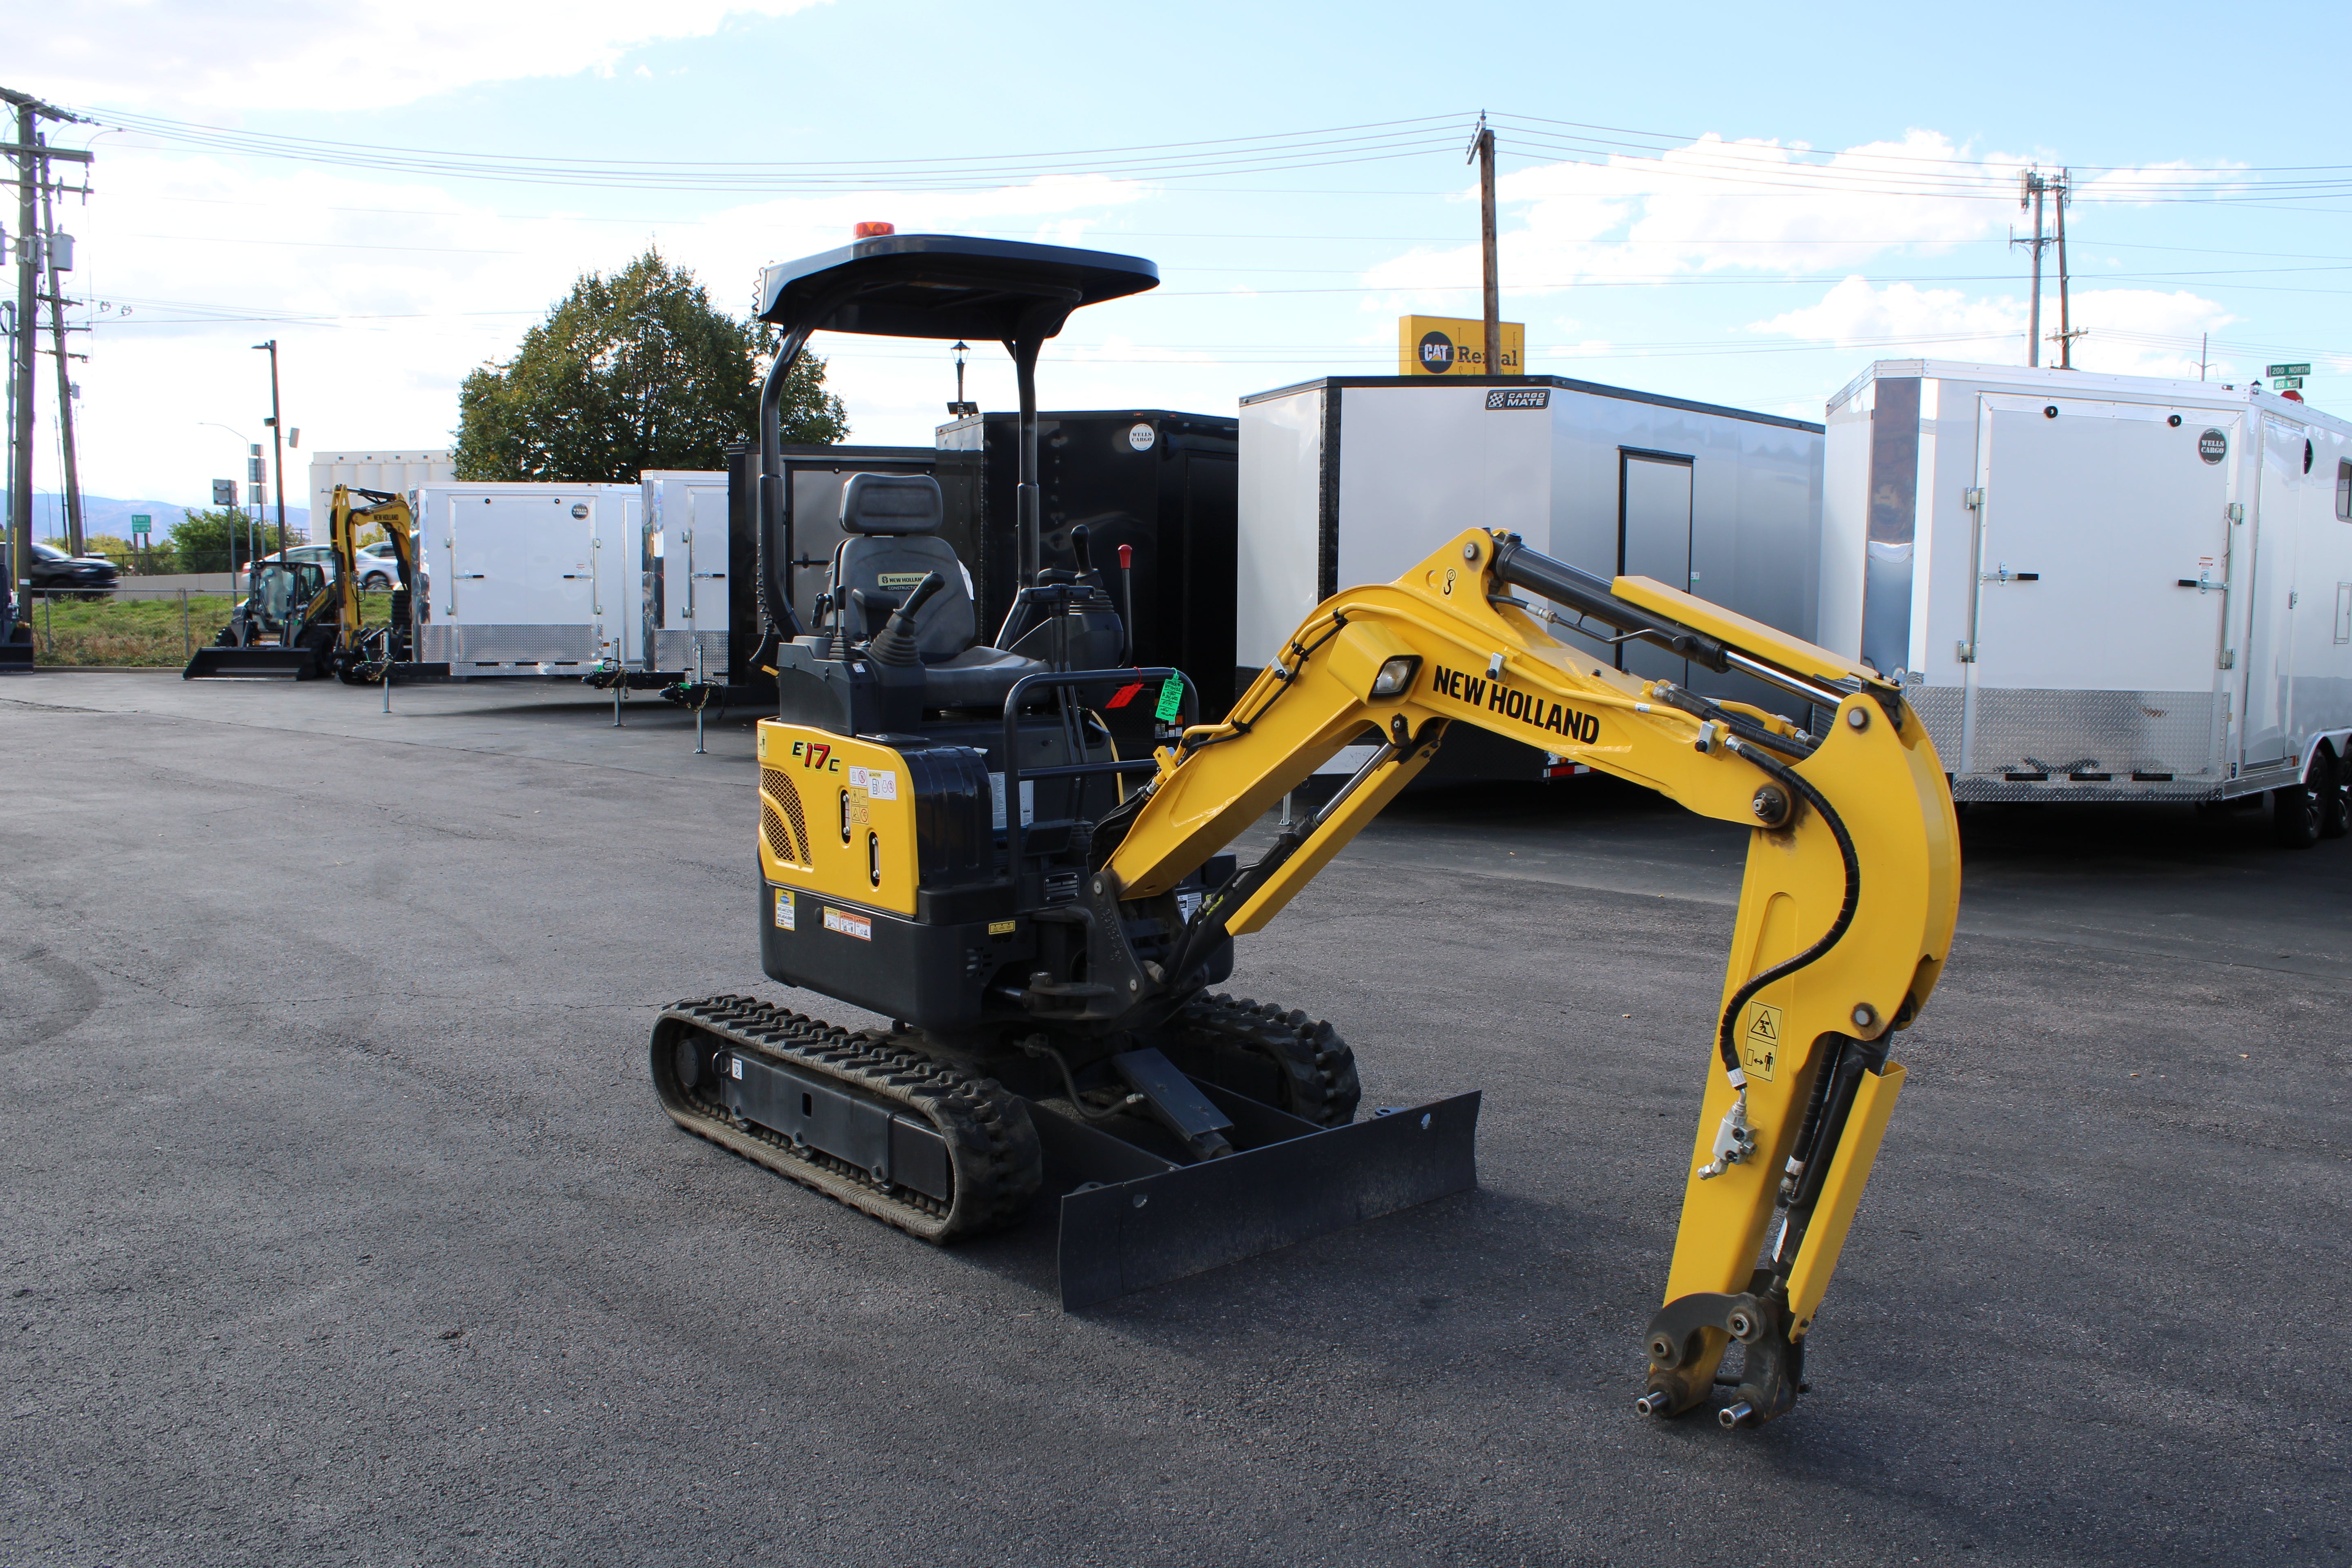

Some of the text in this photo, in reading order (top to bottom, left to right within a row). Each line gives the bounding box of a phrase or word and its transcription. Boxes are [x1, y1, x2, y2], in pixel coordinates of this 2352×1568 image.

[1457, 327, 1517, 348] TE
[1424, 344, 1448, 361] CAT
[1457, 346, 1517, 366] Real
[2276, 380, 2284, 388] 650
[1507, 398, 1545, 406] MATE
[1432, 665, 1599, 745] NEW HOLLAND
[792, 741, 840, 772] E17C
